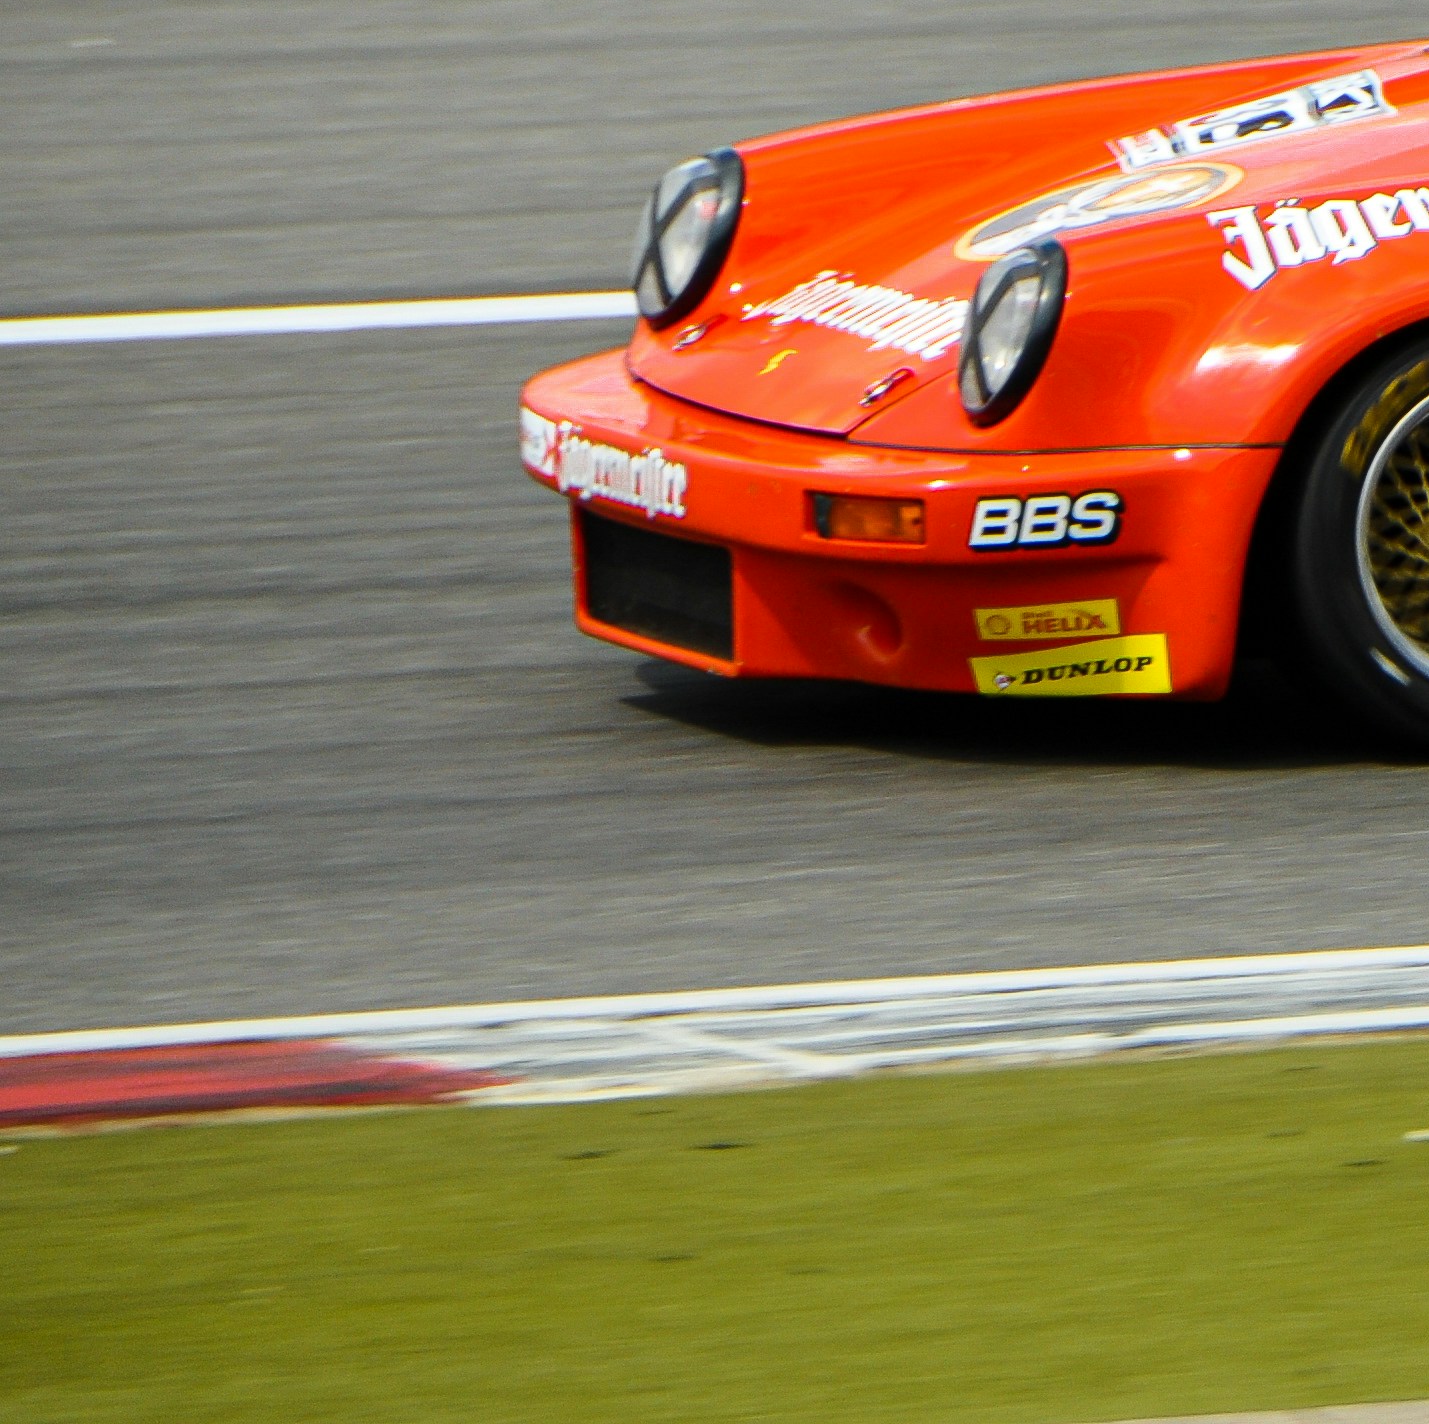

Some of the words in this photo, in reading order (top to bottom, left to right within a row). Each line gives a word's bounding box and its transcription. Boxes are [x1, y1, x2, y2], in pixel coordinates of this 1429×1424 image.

[969, 491, 1121, 548] BBS
[1022, 613, 1107, 635] HELIX
[1021, 655, 1153, 685] DUNLOP
